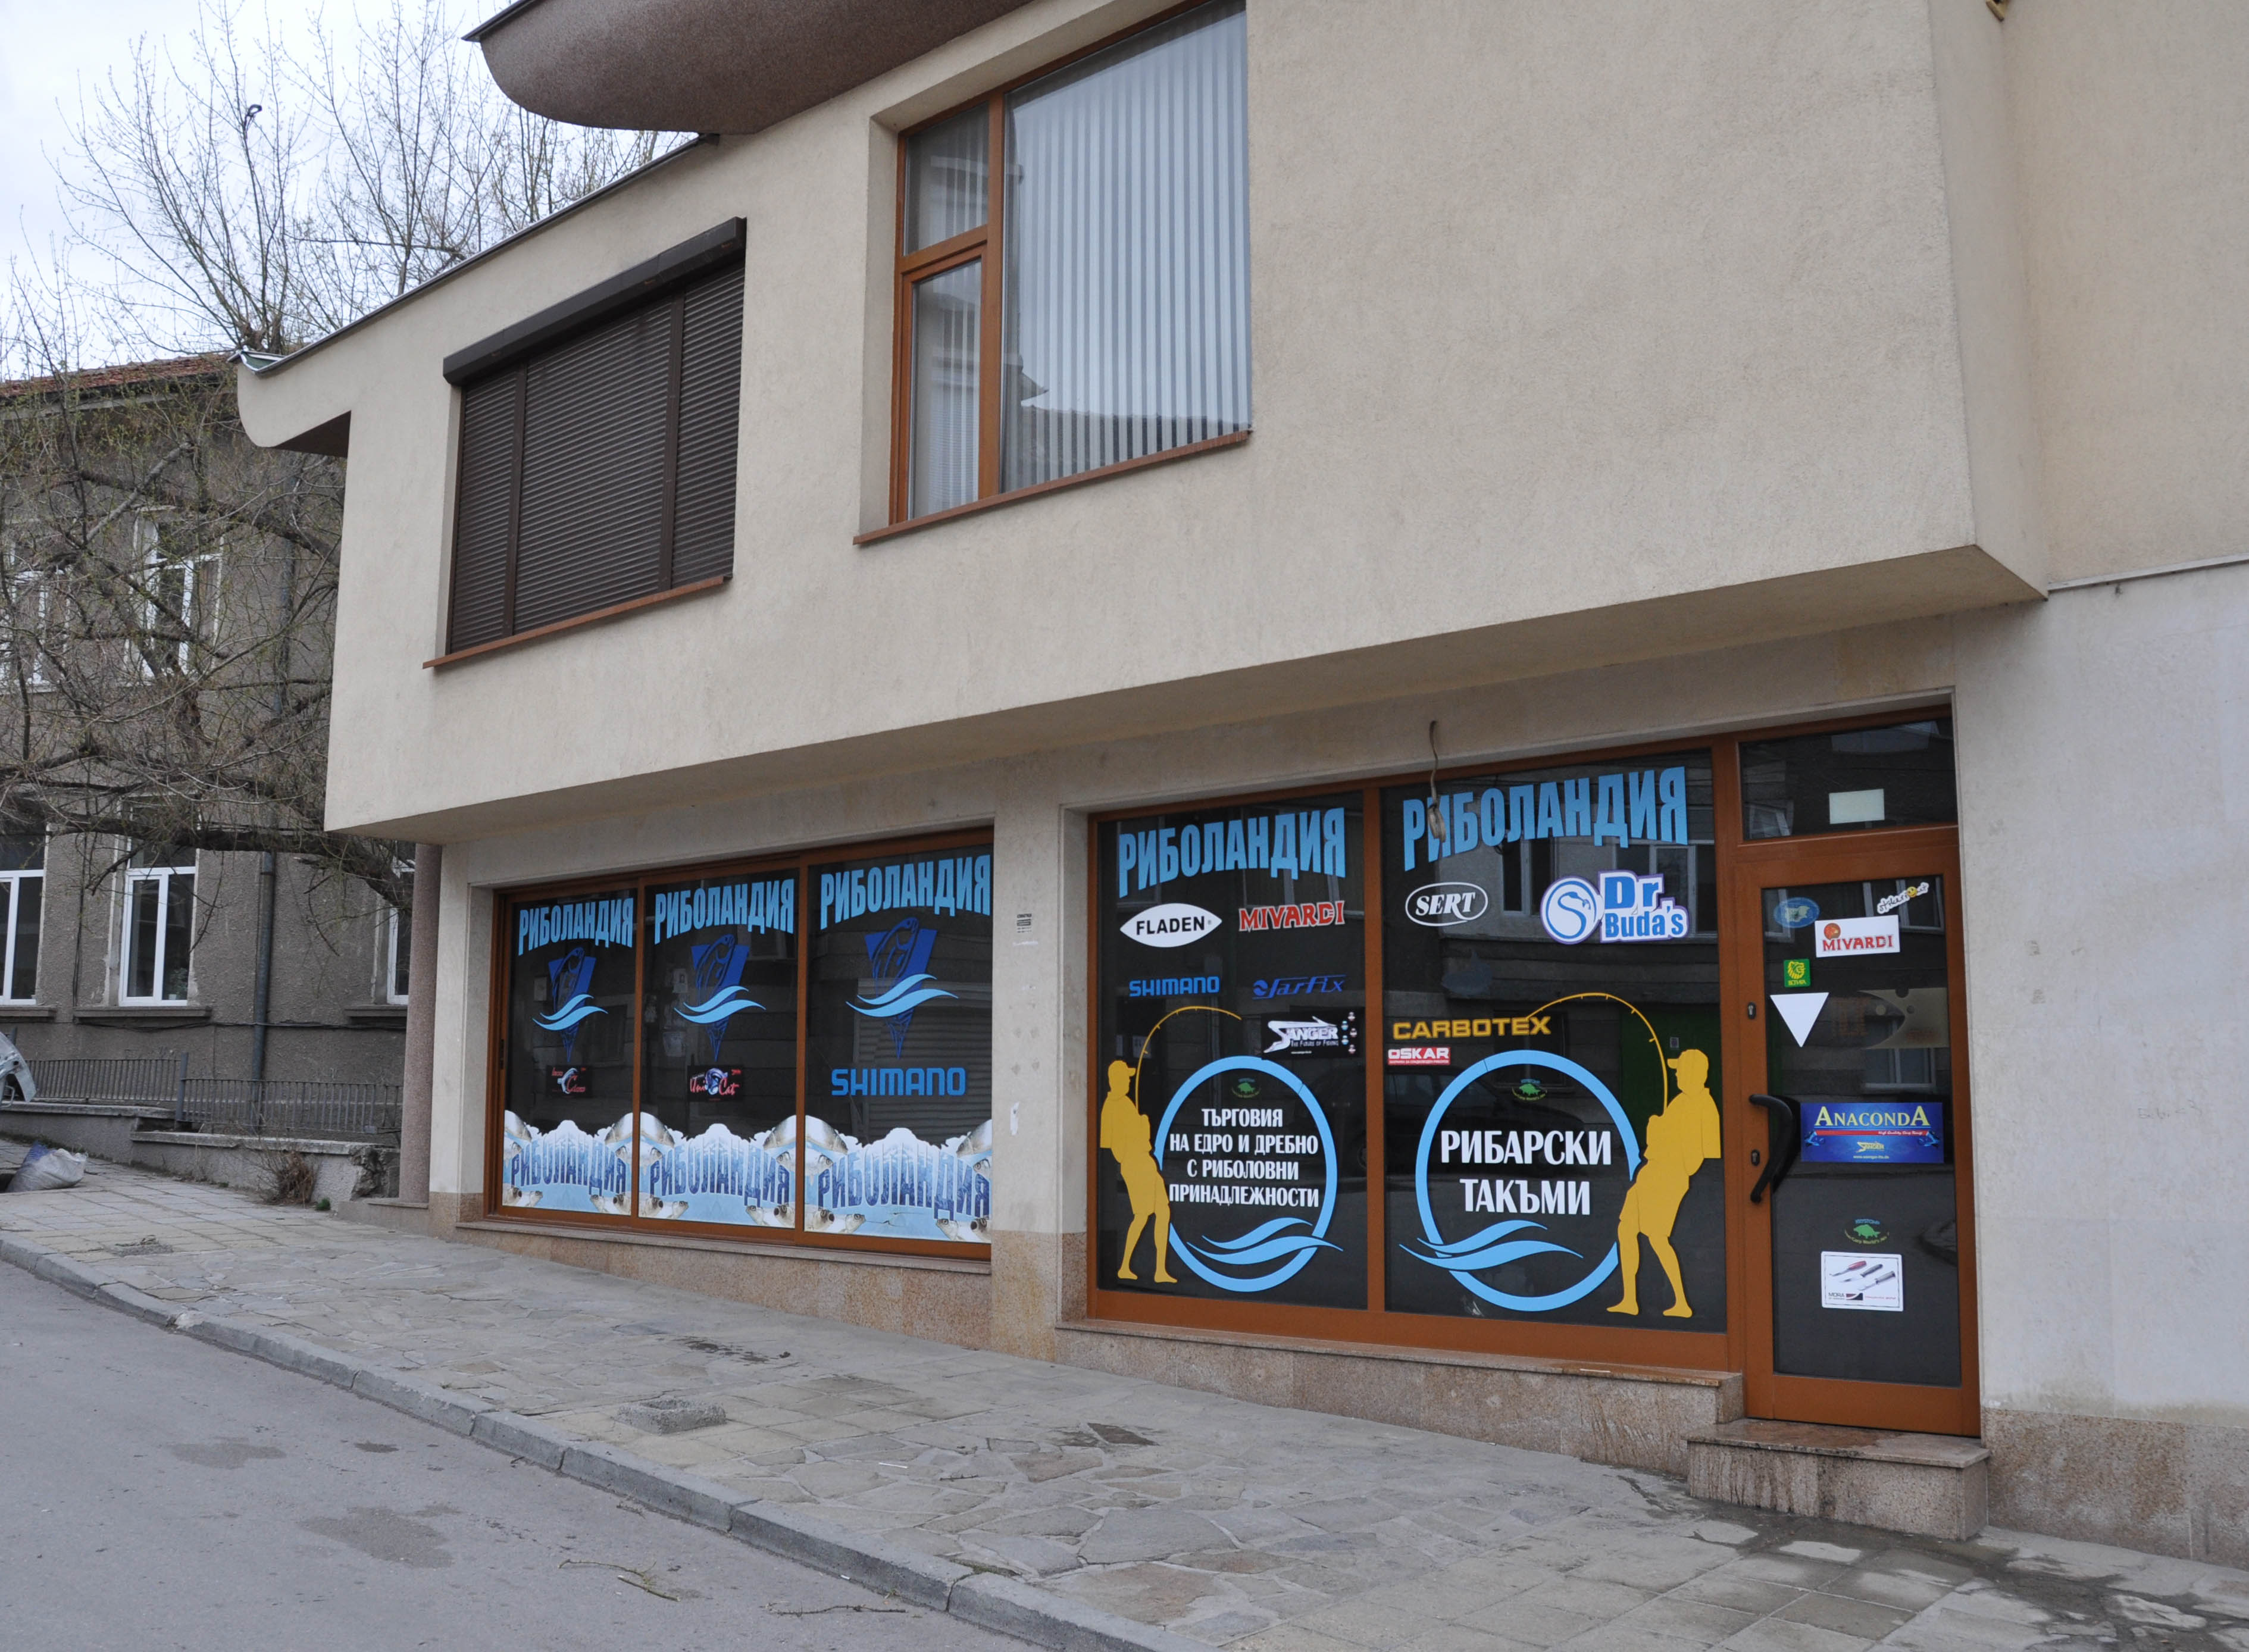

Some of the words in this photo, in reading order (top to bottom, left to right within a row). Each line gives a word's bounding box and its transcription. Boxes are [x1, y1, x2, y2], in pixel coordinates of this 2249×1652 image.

[1403, 766, 1688, 872] РИБОЛАНДИЯ
[1119, 807, 1346, 899] РИБОЛАНДИЯ
[820, 854, 991, 930] РИБОЛАНДИЯ
[1415, 892, 1476, 918] SERT
[1604, 876, 1659, 909] Dr
[654, 878, 794, 945] РИБОЛАНДИЯ
[1136, 915, 1205, 935] FLADEN
[1238, 900, 1345, 932] MIVARDI
[1604, 906, 1684, 938] Buda's
[518, 897, 634, 956] РИБОЛАНДИЯ
[1822, 934, 1893, 952] MIVARDI
[1129, 976, 1220, 997] SHIMANO
[1393, 1016, 1552, 1040] CARBOTEX
[1387, 1047, 1449, 1059] OSKAR
[831, 1067, 966, 1096] SHIMANO
[1201, 1108, 1283, 1128] ТЪРГОВИЯ
[1169, 1133, 1190, 1152] НА
[1194, 1134, 1233, 1154] ЕДРО
[1238, 1134, 1250, 1153] И
[1254, 1134, 1319, 1156] ДРЕБНО
[1441, 1130, 1612, 1165] РИБАРСКИ
[1187, 1159, 1197, 1178] С
[1202, 1160, 1299, 1181] РИБОЛОВНИ
[1168, 1184, 1319, 1208] ПРИНАДЛЕЖНОСТИ
[1459, 1178, 1590, 1215] ТАКЪМИ
